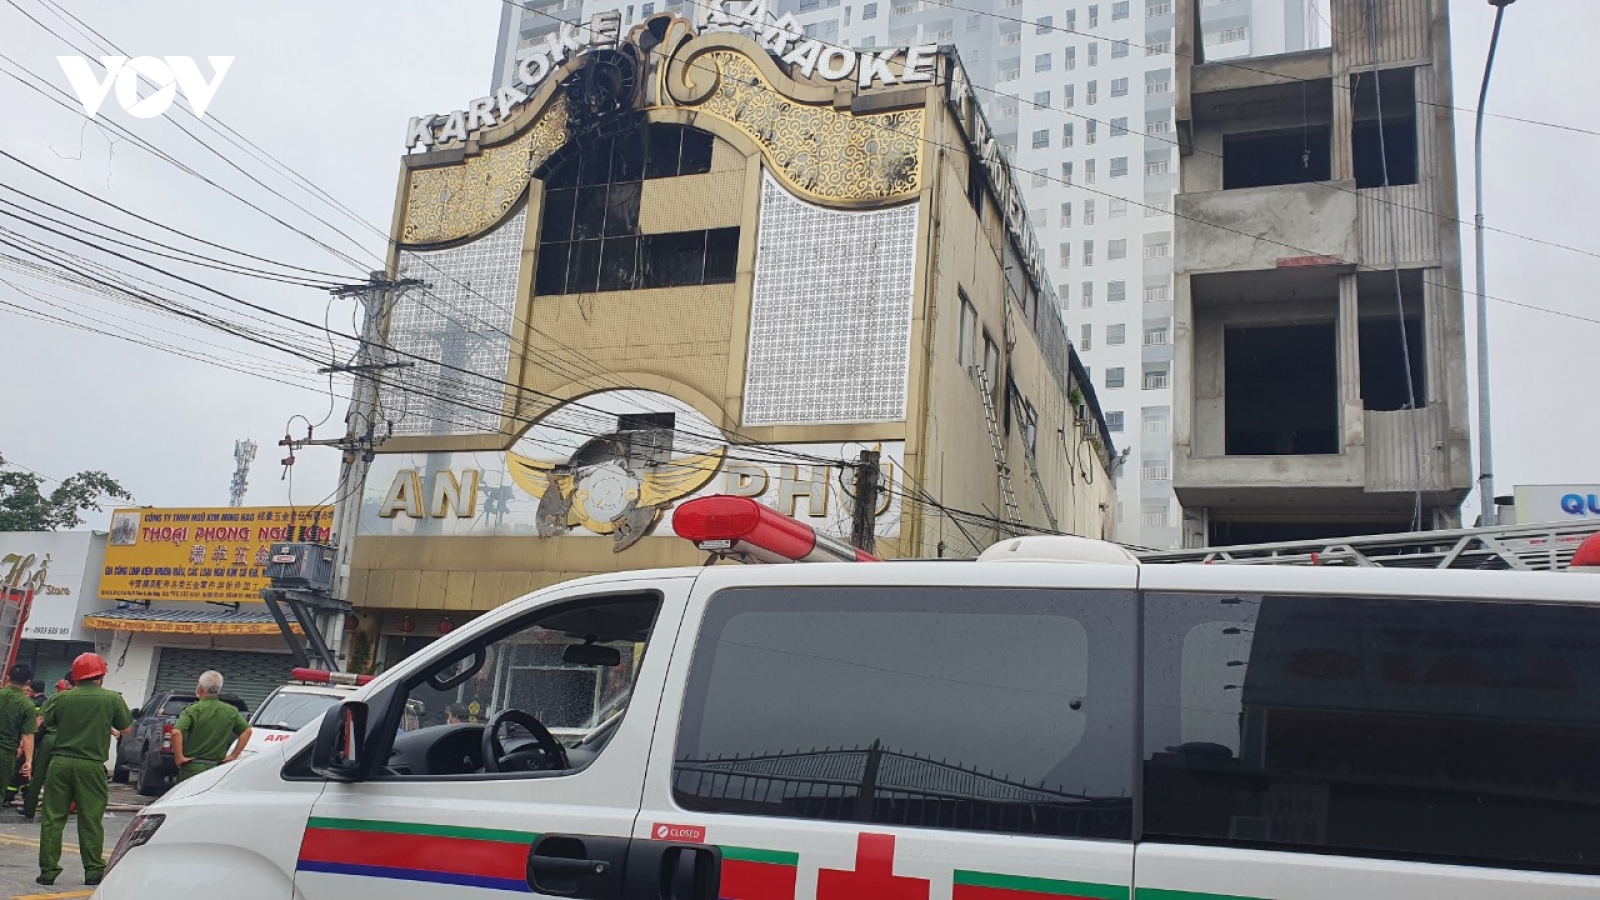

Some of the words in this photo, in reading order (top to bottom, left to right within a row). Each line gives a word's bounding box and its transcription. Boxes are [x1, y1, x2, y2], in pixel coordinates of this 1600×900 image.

[697, 0, 938, 90] KARAOKE
[405, 9, 621, 148] KARAOKE
[378, 469, 480, 518] AN
[142, 527, 189, 546] THOẠI
[195, 527, 251, 541] PHONG
[46, 585, 70, 595] Store
[124, 621, 152, 629] PHONG
[670, 828, 700, 838] CLOSED
